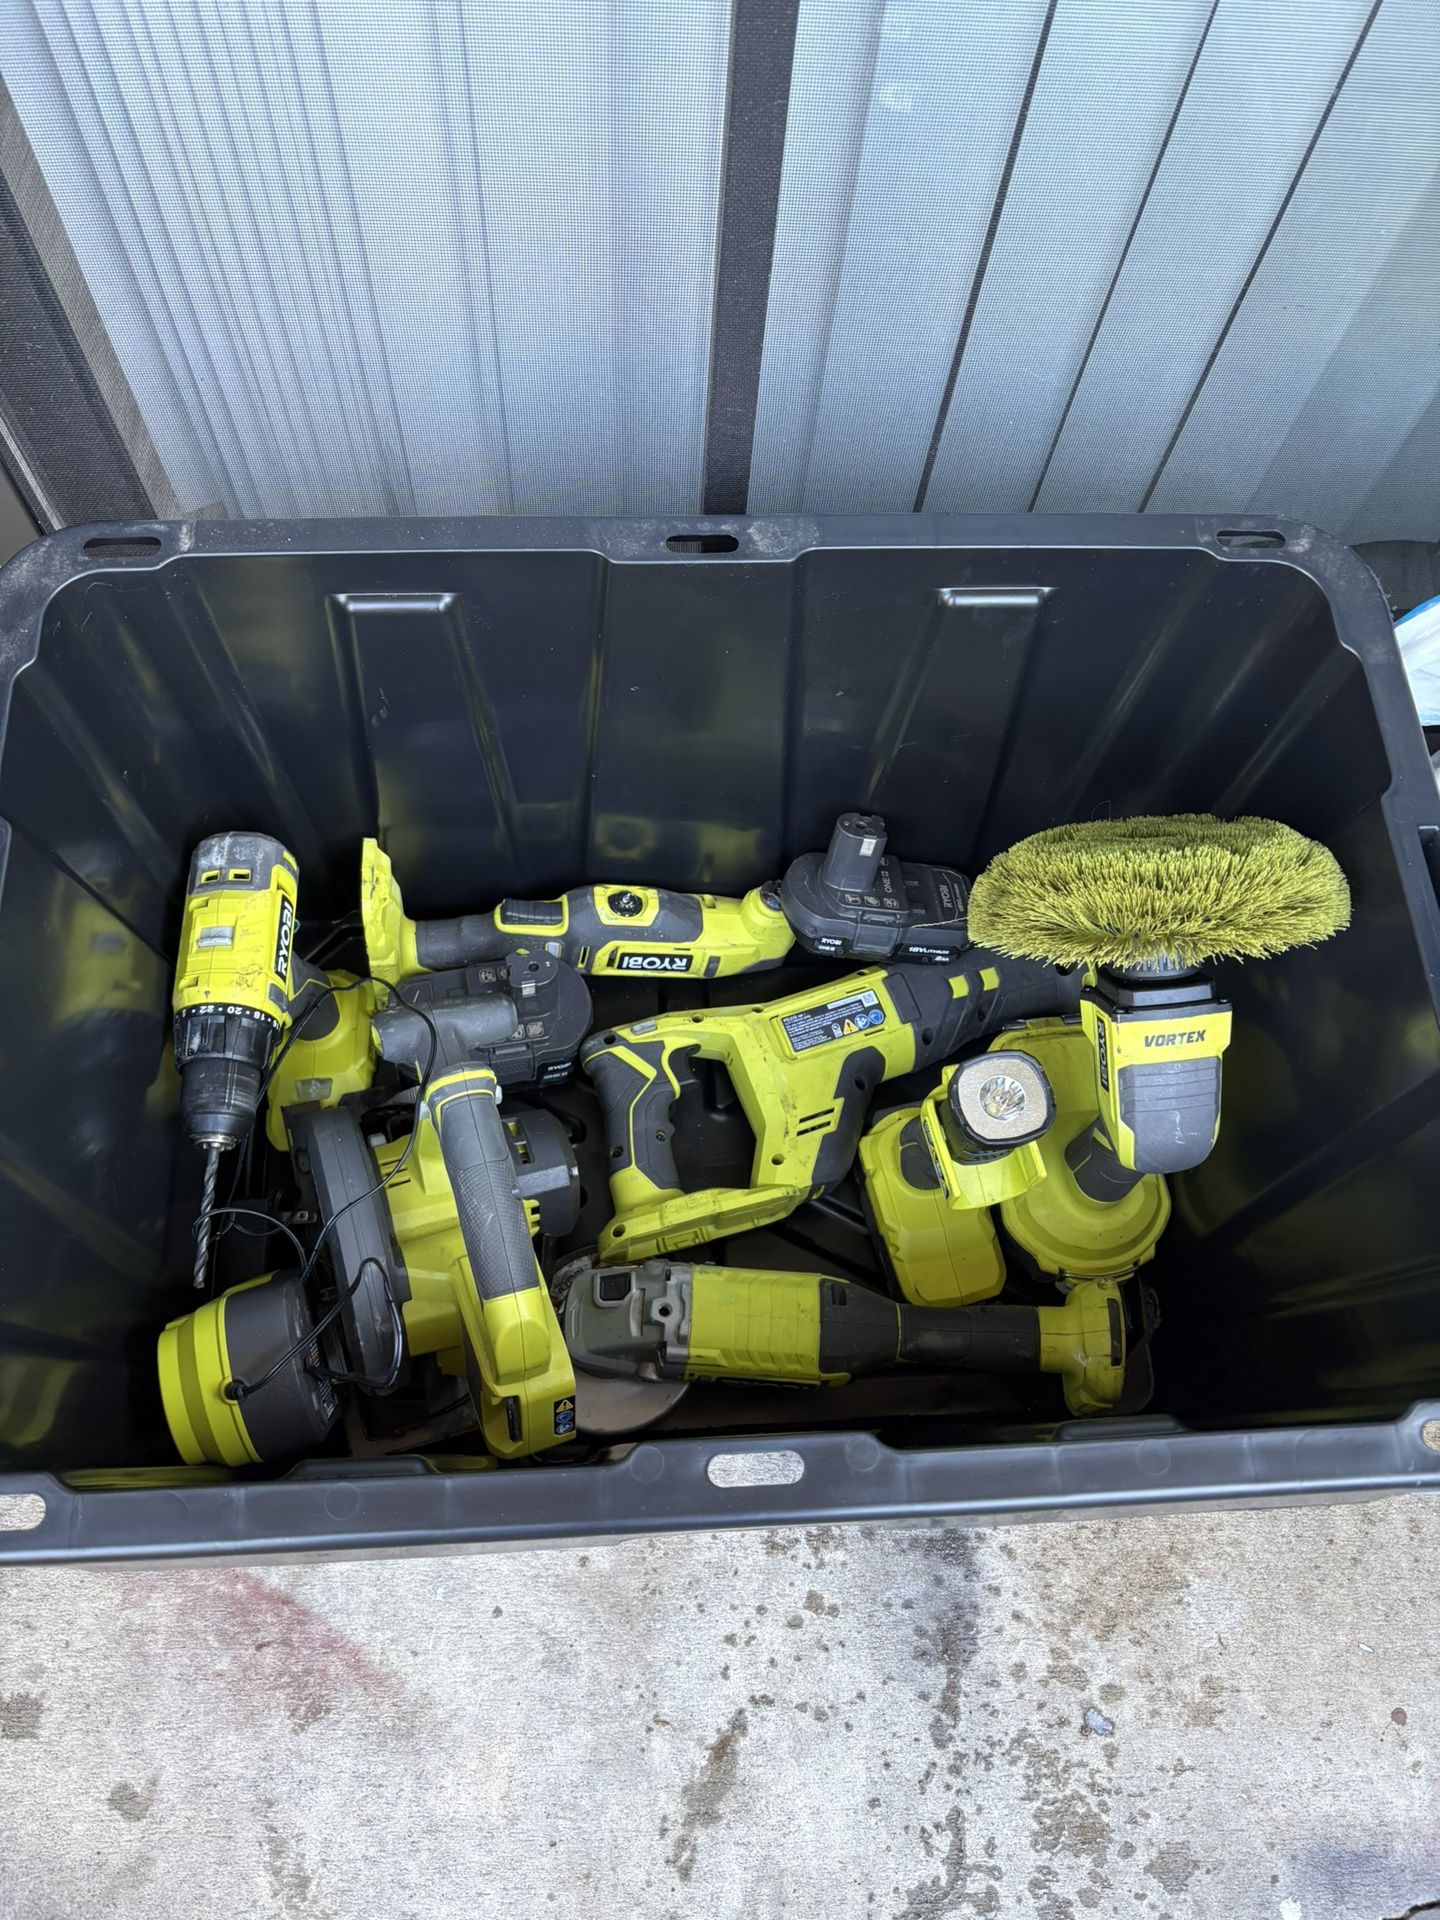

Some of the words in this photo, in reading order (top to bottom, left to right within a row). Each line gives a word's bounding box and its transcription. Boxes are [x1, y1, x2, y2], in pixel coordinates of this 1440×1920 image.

[939, 884, 953, 909] RYOBI
[277, 900, 293, 977] RYOBI
[820, 937, 843, 946] RYOBI
[621, 955, 688, 971] RYOBI
[199, 1005, 216, 1014] 22
[226, 1005, 243, 1016] 20
[253, 1010, 266, 1021] 18
[1144, 1029, 1207, 1048] VORTEX
[1097, 1021, 1108, 1087] RYOBI
